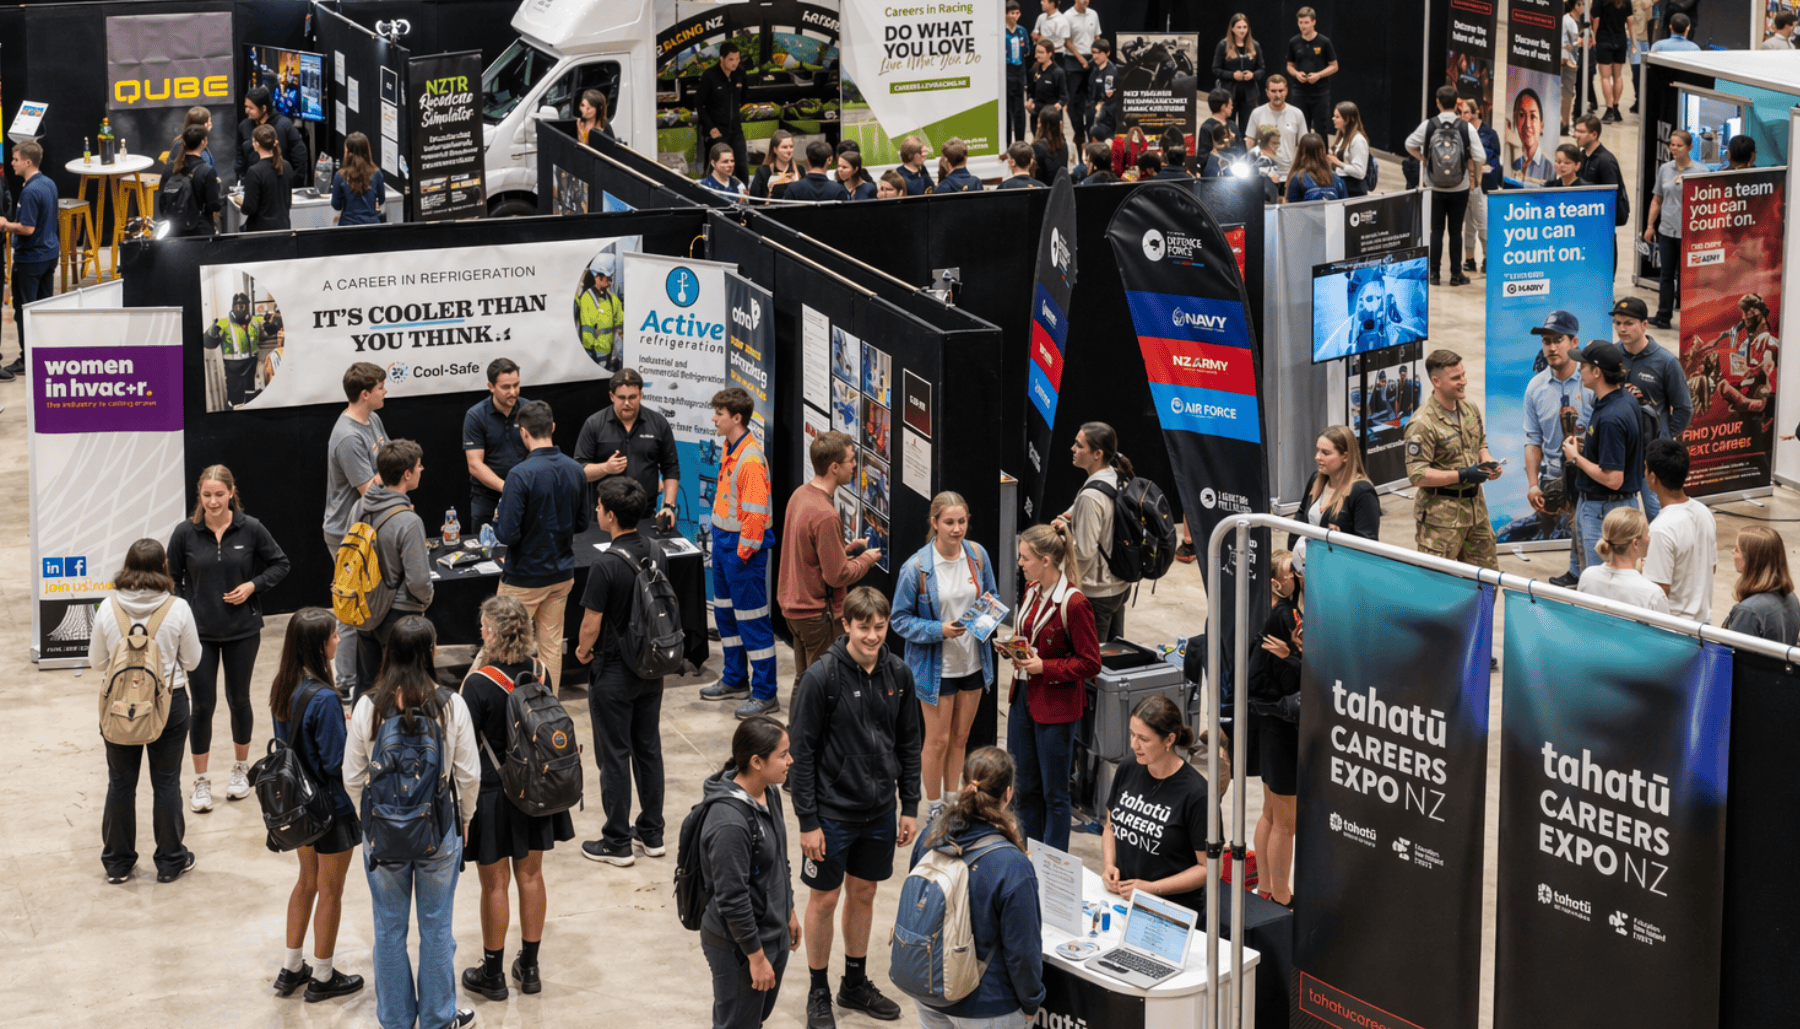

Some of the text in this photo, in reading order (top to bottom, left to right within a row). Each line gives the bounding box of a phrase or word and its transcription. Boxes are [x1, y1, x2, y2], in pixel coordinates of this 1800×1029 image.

[884, 2, 974, 17] Careers in Racing
[705, 15, 724, 31] NZ
[885, 20, 974, 41] DO WHAT
[883, 37, 975, 59] YOU LOVE
[114, 75, 228, 104] QUBE
[425, 75, 468, 95] NZTR
[1690, 182, 1774, 201] Join a team
[1503, 202, 1605, 221] Join a team
[1690, 200, 1747, 220] you can
[1689, 214, 1756, 231] count on.
[1503, 225, 1575, 248] you can
[1503, 245, 1555, 265] count
[322, 265, 536, 291] A CAREER IN REFRIGERATION
[312, 294, 548, 329] IT'S COOLER THAN
[1185, 312, 1227, 329] NAVY
[639, 310, 725, 340] Active
[351, 331, 404, 352] YOU
[639, 334, 724, 354] refrigeration
[44, 359, 134, 375] women
[412, 361, 480, 378] Cool-Safe
[45, 378, 153, 398] in hvac+r.
[1185, 402, 1238, 419] AIR FORCE
[45, 580, 70, 594] Join
[1332, 679, 1447, 749] tahatū
[1331, 725, 1447, 785] CAREERS
[1331, 756, 1446, 823] EXPO NZ
[1541, 741, 1670, 817] tahatū
[1119, 790, 1171, 823] tahatū
[1110, 807, 1164, 839] CAREERS
[1540, 789, 1670, 857] CAREERS
[1139, 835, 1160, 856] NZ
[1539, 822, 1669, 897] EXPO NZ
